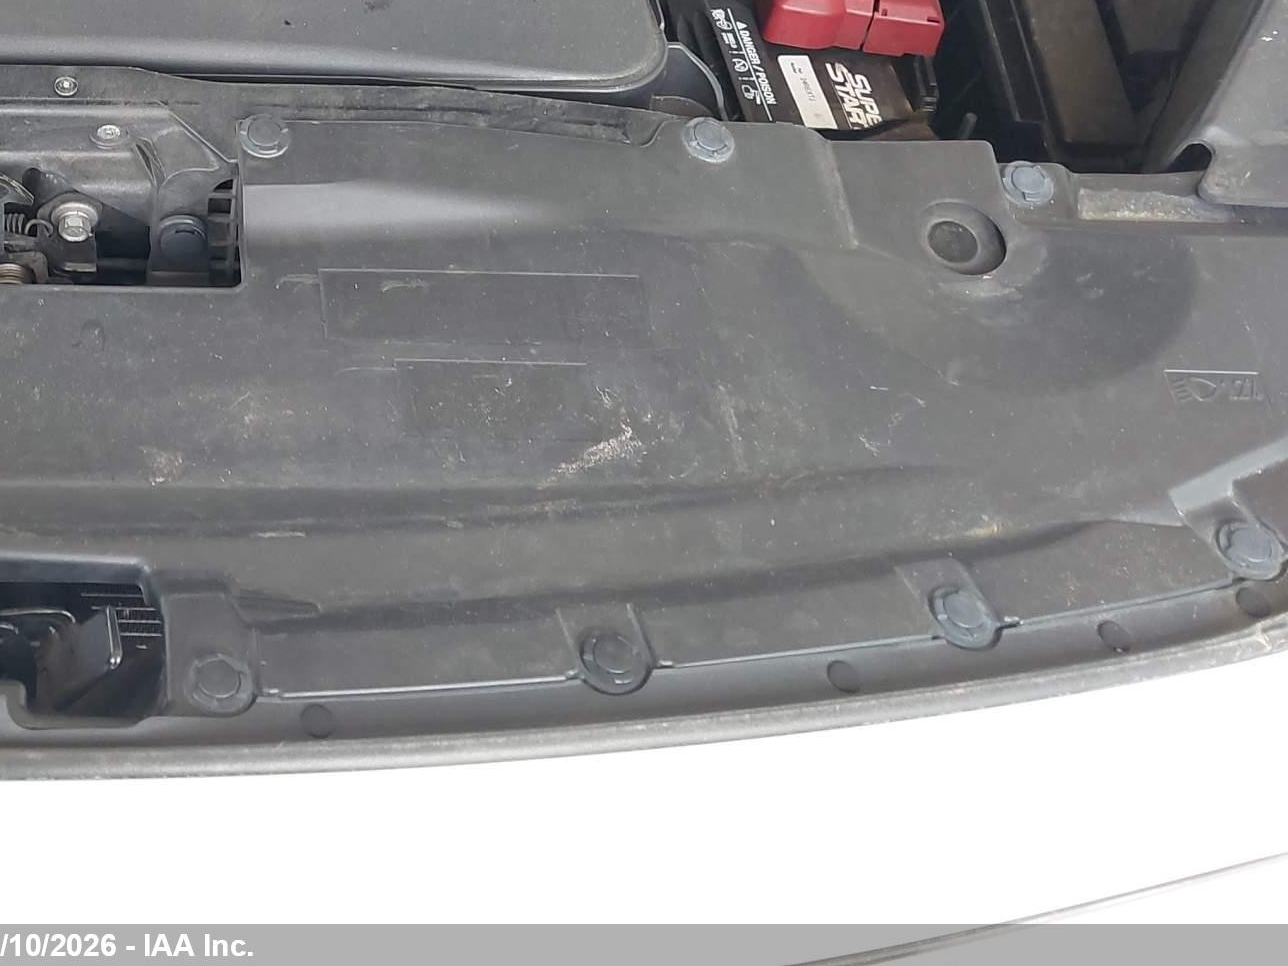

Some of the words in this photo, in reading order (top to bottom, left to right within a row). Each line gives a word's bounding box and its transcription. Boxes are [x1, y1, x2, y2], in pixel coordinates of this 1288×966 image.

[739, 30, 761, 65] DANGER
[756, 72, 777, 105] POISON
[825, 62, 870, 130] STAR
[850, 73, 883, 127] SUPE
